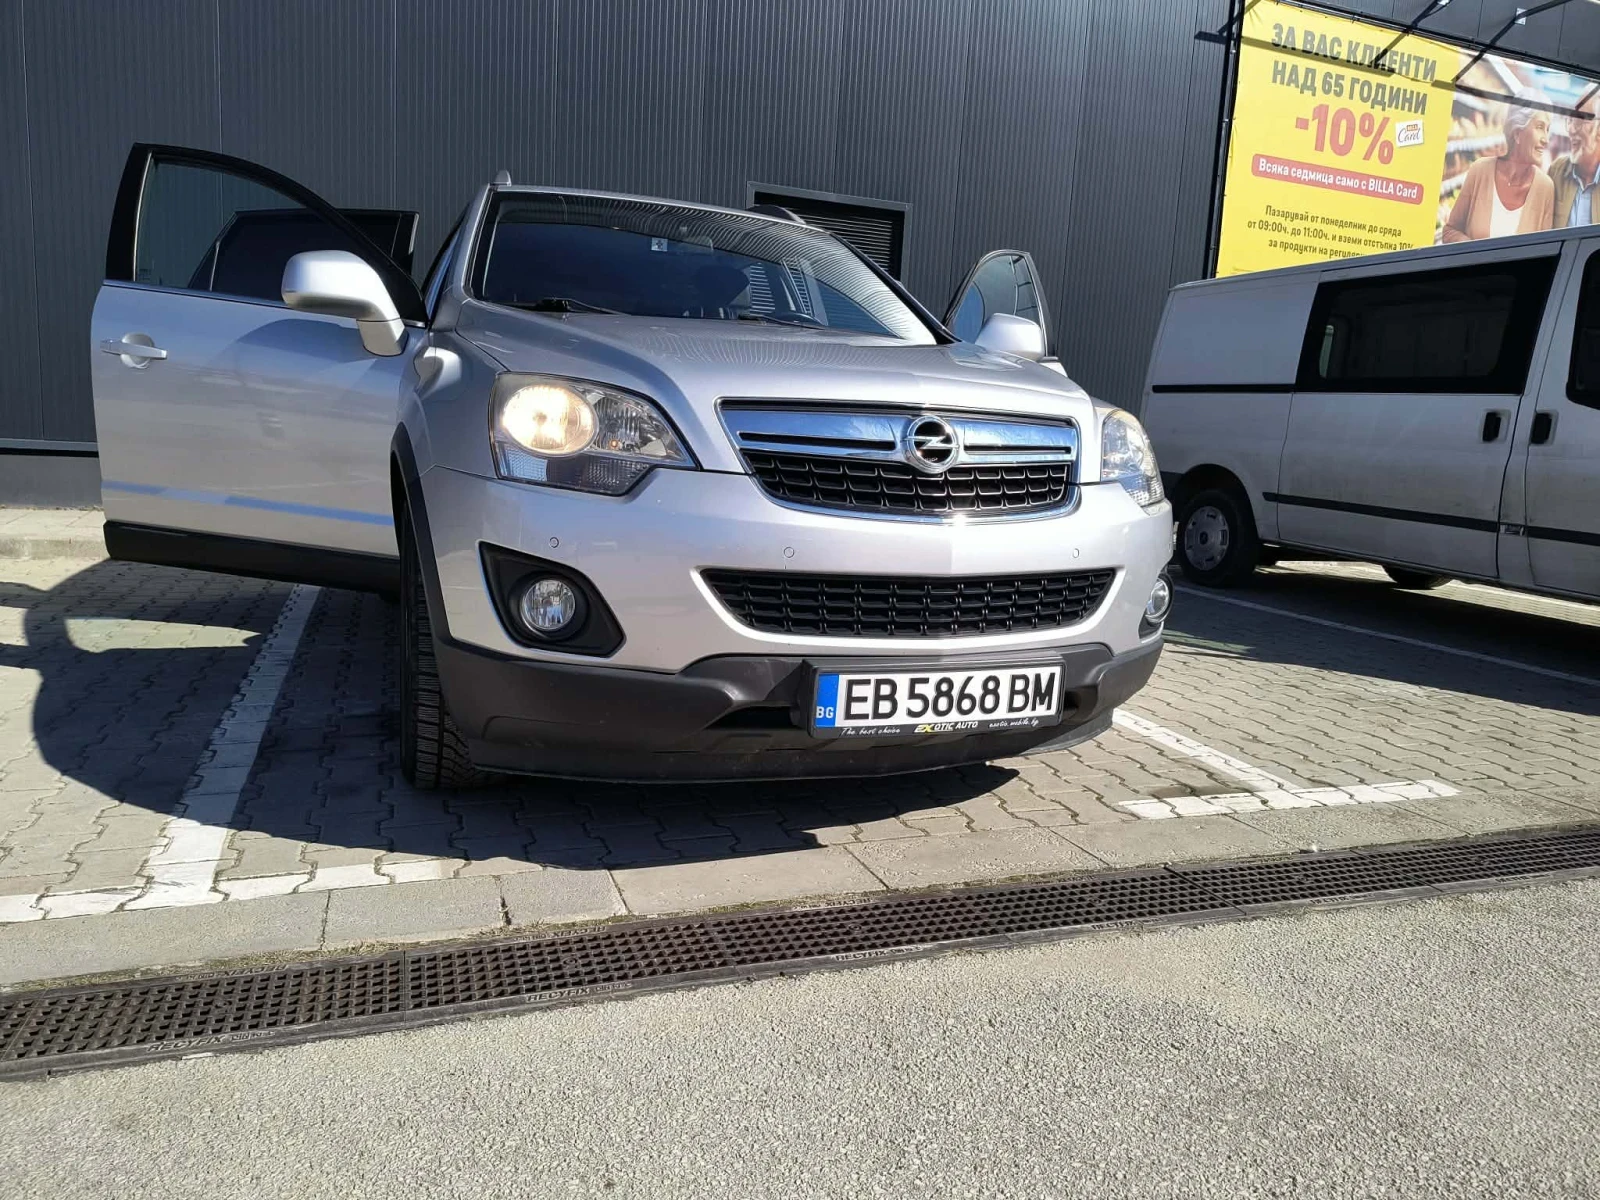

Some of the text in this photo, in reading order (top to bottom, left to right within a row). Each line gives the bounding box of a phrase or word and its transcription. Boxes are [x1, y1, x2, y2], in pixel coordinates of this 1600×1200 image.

[1272, 23, 1437, 82] ЗА ВАС КЛИЕНТИ
[1272, 60, 1428, 115] НАД 65 ГОДИНИ
[1295, 104, 1394, 165] -10%
[1398, 128, 1421, 143] Card
[1259, 158, 1419, 199] Всяка седмица само с BILLA Card
[1247, 220, 1256, 229] от
[1258, 220, 1289, 235] 09:00ч.
[1290, 228, 1302, 237] до
[1303, 227, 1330, 241] 11:00ч.
[1331, 234, 1337, 242] и
[1338, 235, 1362, 246] вземи
[1363, 239, 1397, 251] отстъпка
[1265, 205, 1309, 222] Пазарувай
[1320, 217, 1367, 232] понеделник
[1368, 224, 1378, 234] до
[1379, 226, 1402, 237] сряда
[1268, 239, 1278, 248] за
[1279, 240, 1317, 255] продукти
[1319, 247, 1328, 255] на
[844, 672, 1056, 720] EB 5868 BM
[816, 706, 834, 719] BG
[914, 720, 979, 734] EXOTIC AUTO
